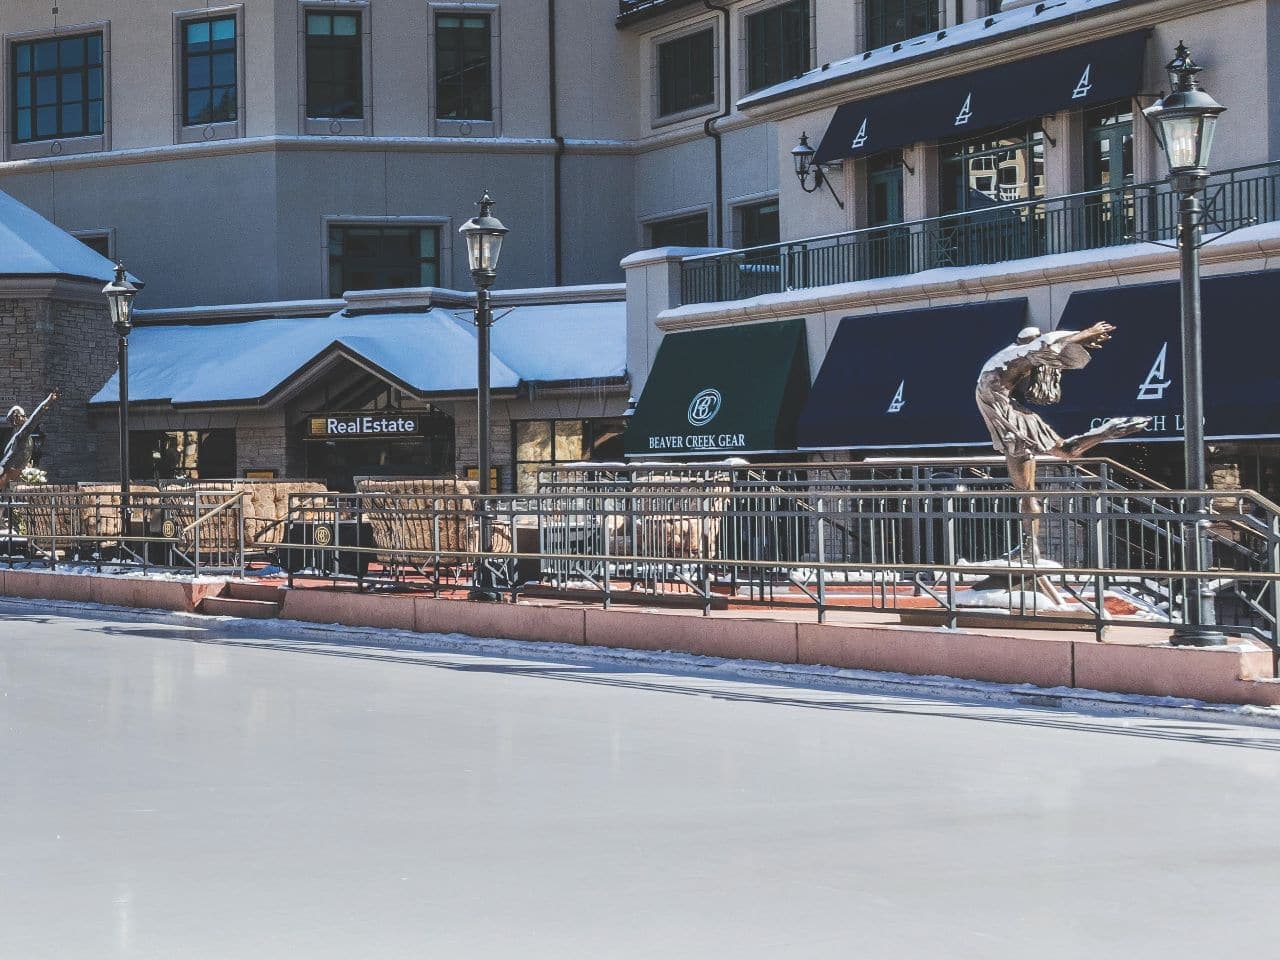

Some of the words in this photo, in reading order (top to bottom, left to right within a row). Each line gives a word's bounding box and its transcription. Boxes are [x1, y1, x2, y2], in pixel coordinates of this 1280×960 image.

[327, 418, 360, 434] Real
[363, 417, 415, 433] Estate
[649, 436, 683, 448] BEAVER
[685, 435, 716, 448] CREEK
[718, 433, 746, 447] GEAR
